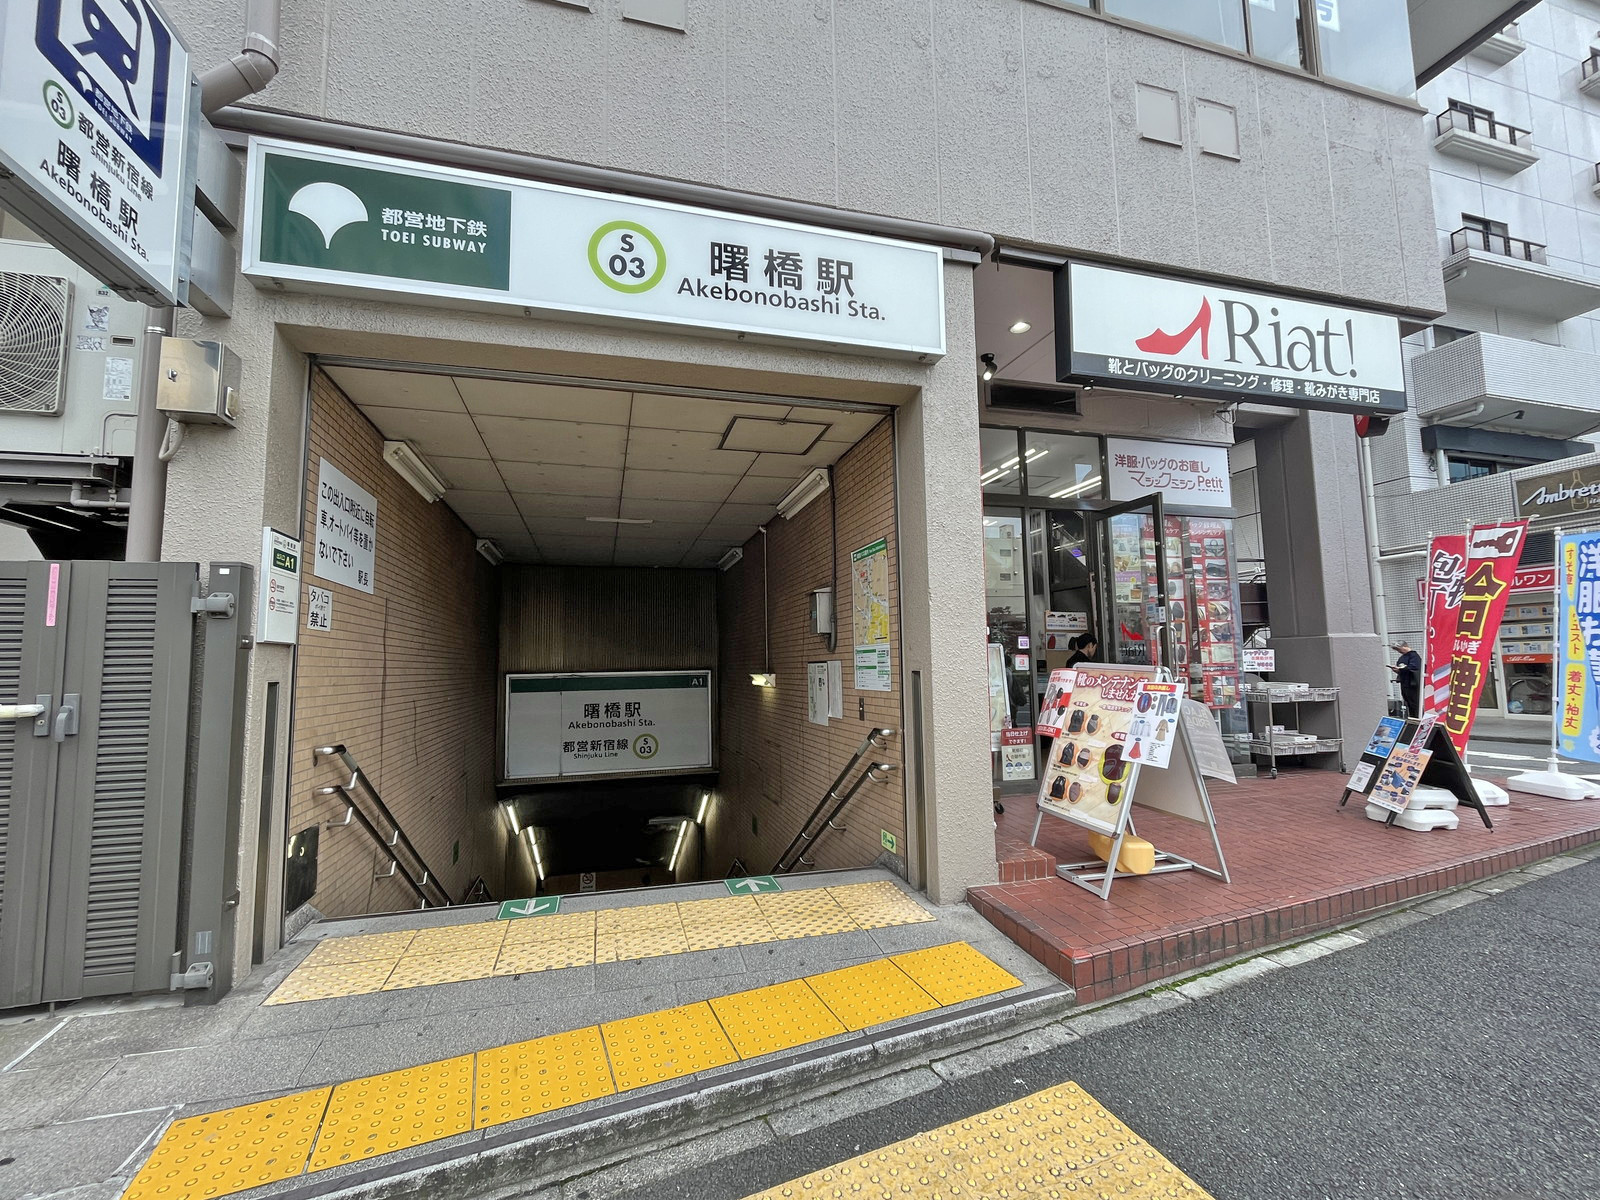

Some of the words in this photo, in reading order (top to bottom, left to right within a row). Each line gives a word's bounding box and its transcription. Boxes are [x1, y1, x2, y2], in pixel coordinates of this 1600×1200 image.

[56, 91, 63, 104] S
[51, 98, 67, 121] 03
[78, 112, 153, 201] 都営新宿線
[91, 145, 125, 187] Shinjuku
[126, 180, 142, 201] Line
[57, 138, 138, 237] 曙橋駅
[40, 159, 128, 243] Akebonobashi
[131, 237, 150, 262] Sta.
[381, 207, 488, 238] 都営地下鉄
[381, 229, 416, 244] TOEI
[422, 234, 487, 254] SUBWAY
[620, 233, 635, 253] S
[608, 254, 646, 279] 03
[709, 241, 855, 298] 曙橋駅
[676, 277, 840, 315] Akebonobashi
[847, 300, 887, 321] Sta.
[1218, 299, 1358, 378] Riat!
[1108, 357, 1380, 404] 靴とバッグのクリーニング・修理・靴みがき専門店
[1114, 453, 1211, 473] 洋服・バッグのお直し
[1128, 470, 1196, 490] マジックミシン
[1197, 475, 1223, 489] Petit
[319, 509, 374, 553] 車オートバイ等を置か
[285, 556, 294, 570] A1
[318, 538, 354, 569] ないで下さい
[357, 569, 369, 587] 駅長
[310, 588, 330, 605] タバコ
[310, 611, 328, 628] 禁止
[691, 677, 704, 686] A1
[584, 702, 641, 719] 曙橋駅
[1564, 671, 1584, 730] 着丈・袖丈
[568, 719, 636, 730] Akebonobashi
[638, 718, 656, 727] Sta.
[563, 738, 629, 753] 都営新宿線
[573, 752, 603, 760] Shinjuku
[639, 745, 652, 754] 03
